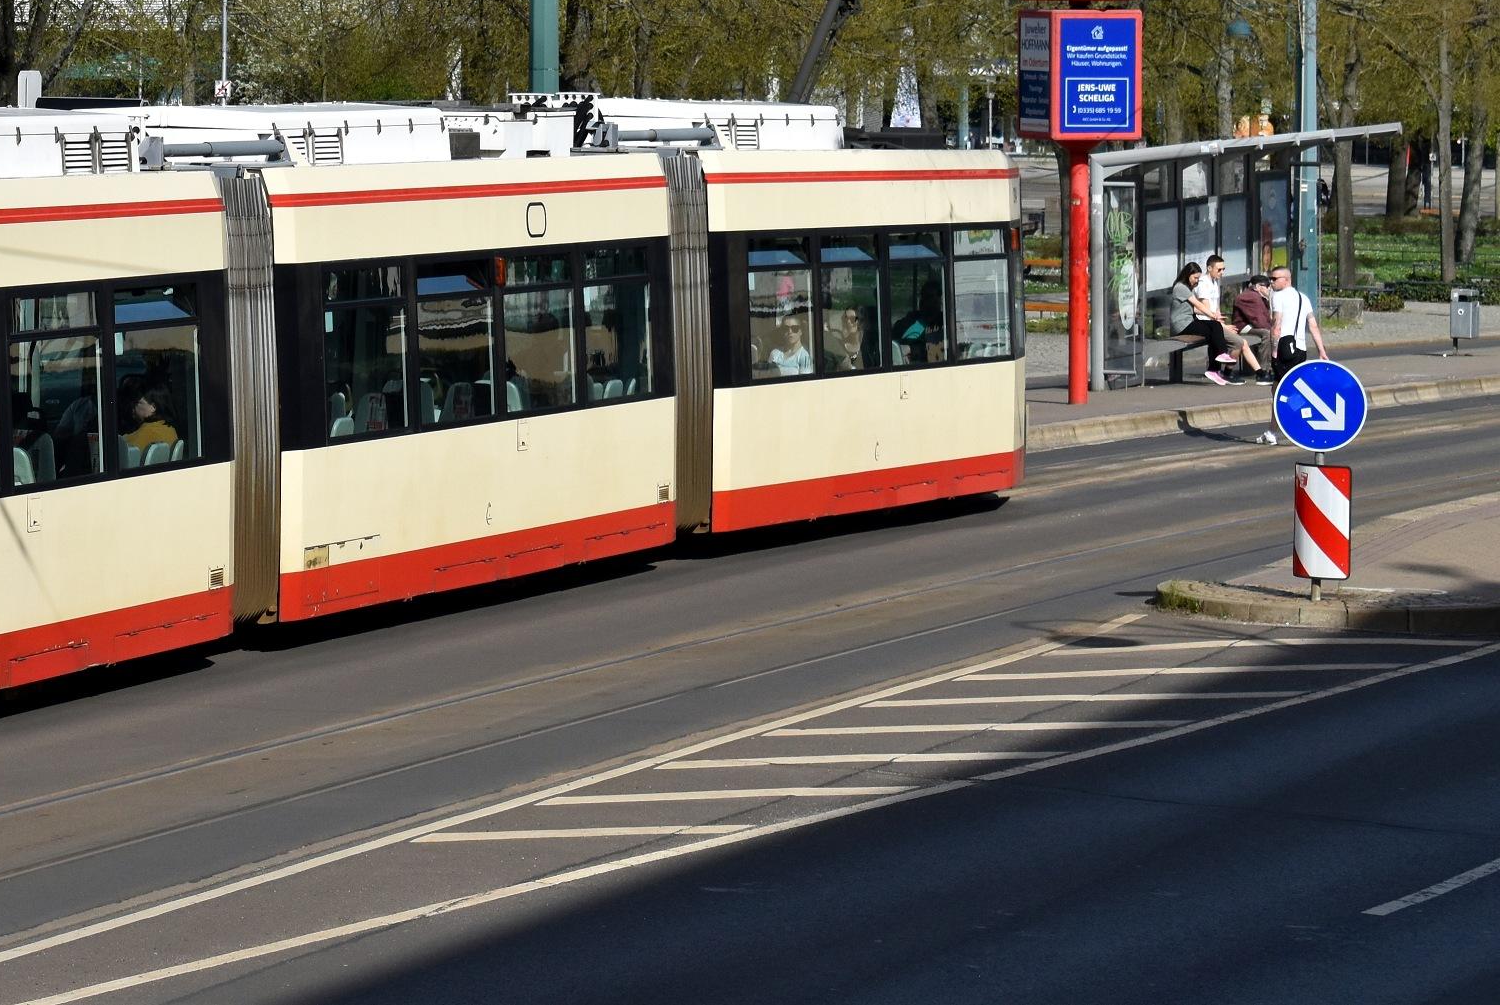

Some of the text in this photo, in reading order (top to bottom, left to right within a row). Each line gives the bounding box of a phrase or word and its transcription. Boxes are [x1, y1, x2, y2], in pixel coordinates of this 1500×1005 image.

[1066, 45, 1128, 53] Eigentümer aufgepasst!
[1077, 83, 1117, 92] JENS-UWE
[1078, 94, 1115, 102] SCHELIGA
[1077, 107, 1095, 115] (0335)
